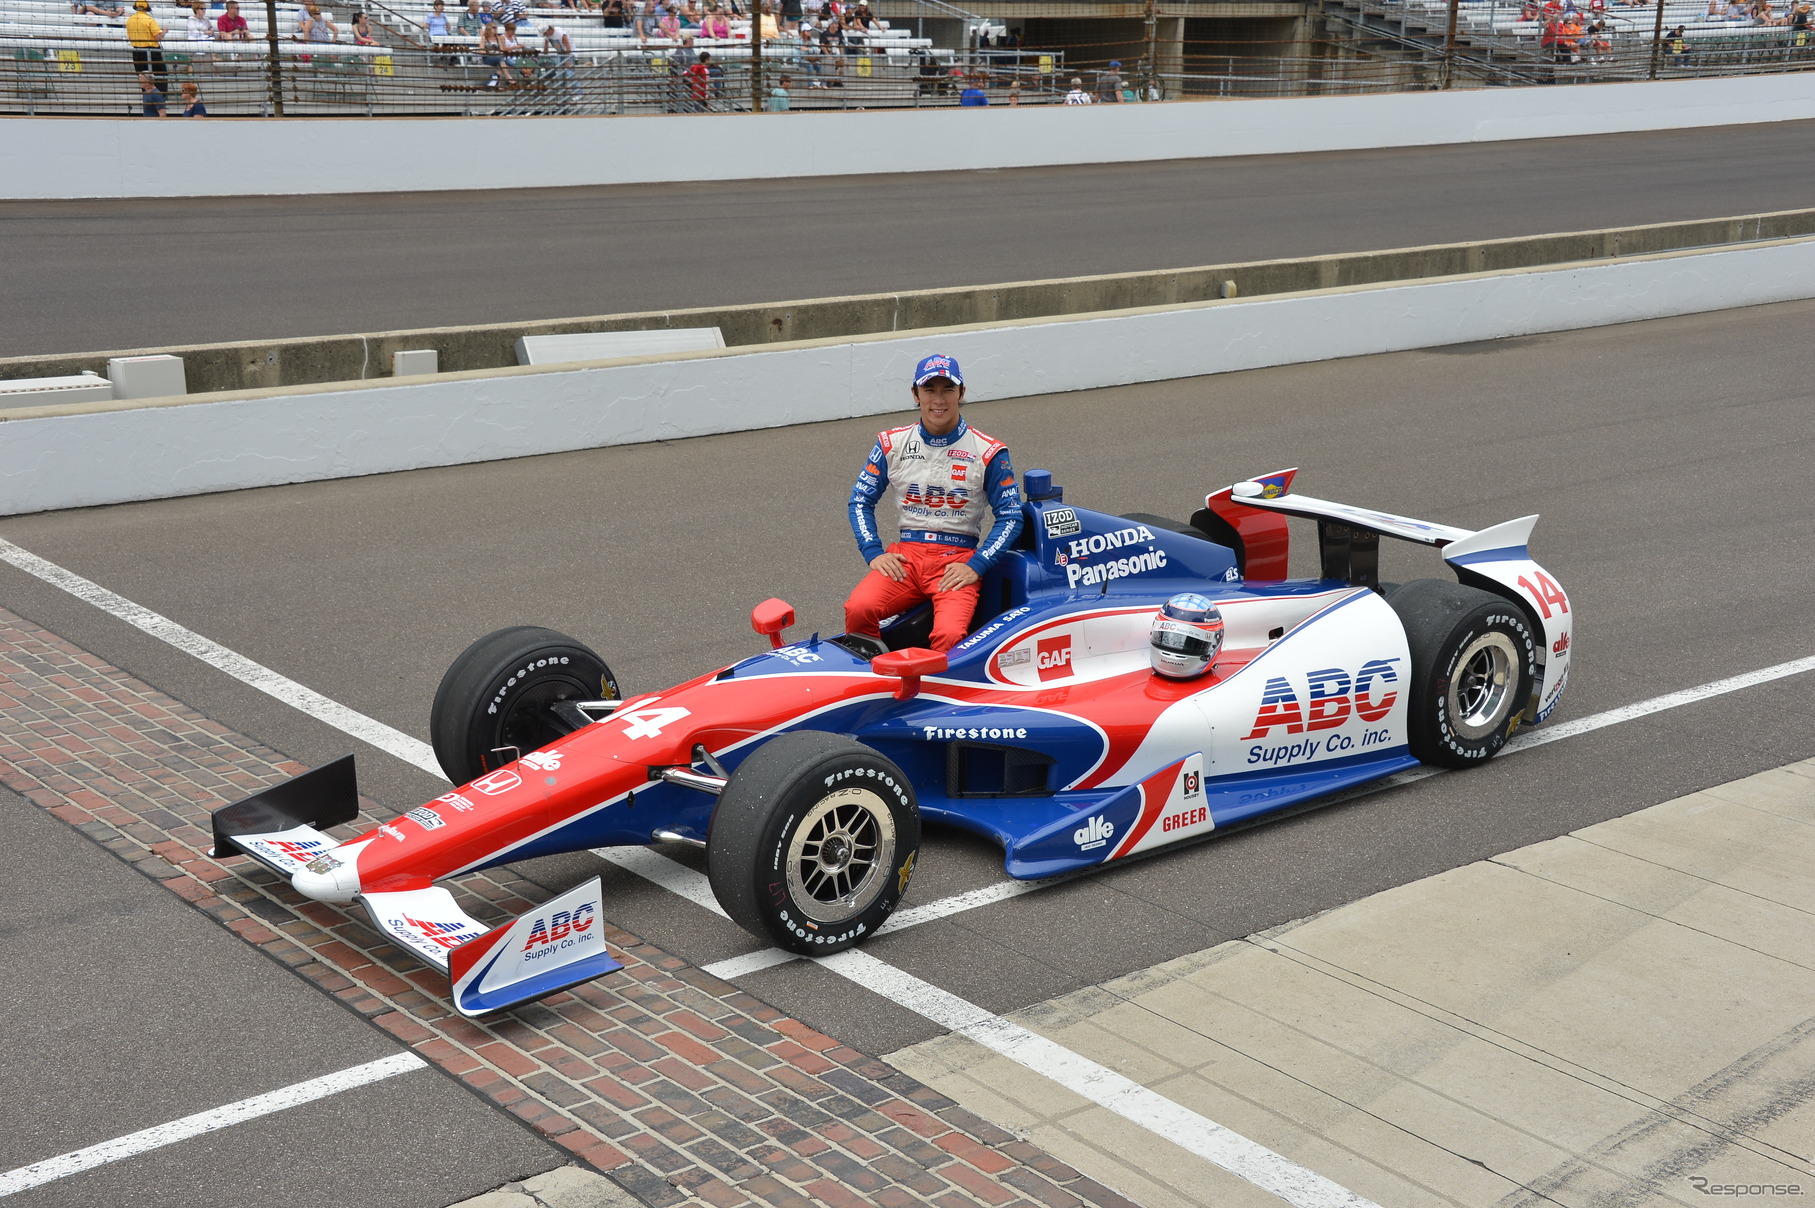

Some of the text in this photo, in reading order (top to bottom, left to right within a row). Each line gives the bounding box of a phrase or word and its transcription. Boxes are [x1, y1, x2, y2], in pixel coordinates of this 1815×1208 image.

[948, 450, 968, 458] IZOD
[951, 469, 966, 477] GAF
[901, 483, 973, 510] ABC
[1001, 487, 1017, 499] ANA
[903, 505, 932, 517] Supply
[934, 509, 949, 517] Co.
[1046, 510, 1074, 526] IZOD
[944, 535, 960, 543] SATO
[982, 519, 1016, 560] Panasonic
[1069, 526, 1156, 559] HONDA
[1066, 546, 1167, 589] Panasonic
[1518, 571, 1569, 620] 14
[957, 606, 1031, 651] TAKUMA SATO
[1159, 622, 1177, 631] ABC
[1037, 647, 1072, 670] GAF
[1486, 614, 1535, 676] Firestone
[487, 655, 570, 715] Firestone
[1240, 657, 1400, 741] ABC
[595, 696, 692, 741] 14
[923, 725, 1027, 740] Firestone
[1438, 696, 1487, 759] Firestone
[523, 749, 564, 771] alfe
[1247, 728, 1392, 766] Supply Co. inc.
[824, 767, 909, 806] Firestone
[1073, 814, 1114, 846] alfe
[1162, 806, 1207, 833] GREER
[774, 814, 794, 870] INDY 500
[388, 919, 427, 943] Supply
[521, 900, 597, 952] ABC
[780, 909, 867, 945] Firestone
[524, 931, 595, 962] Supply Co. inc.
